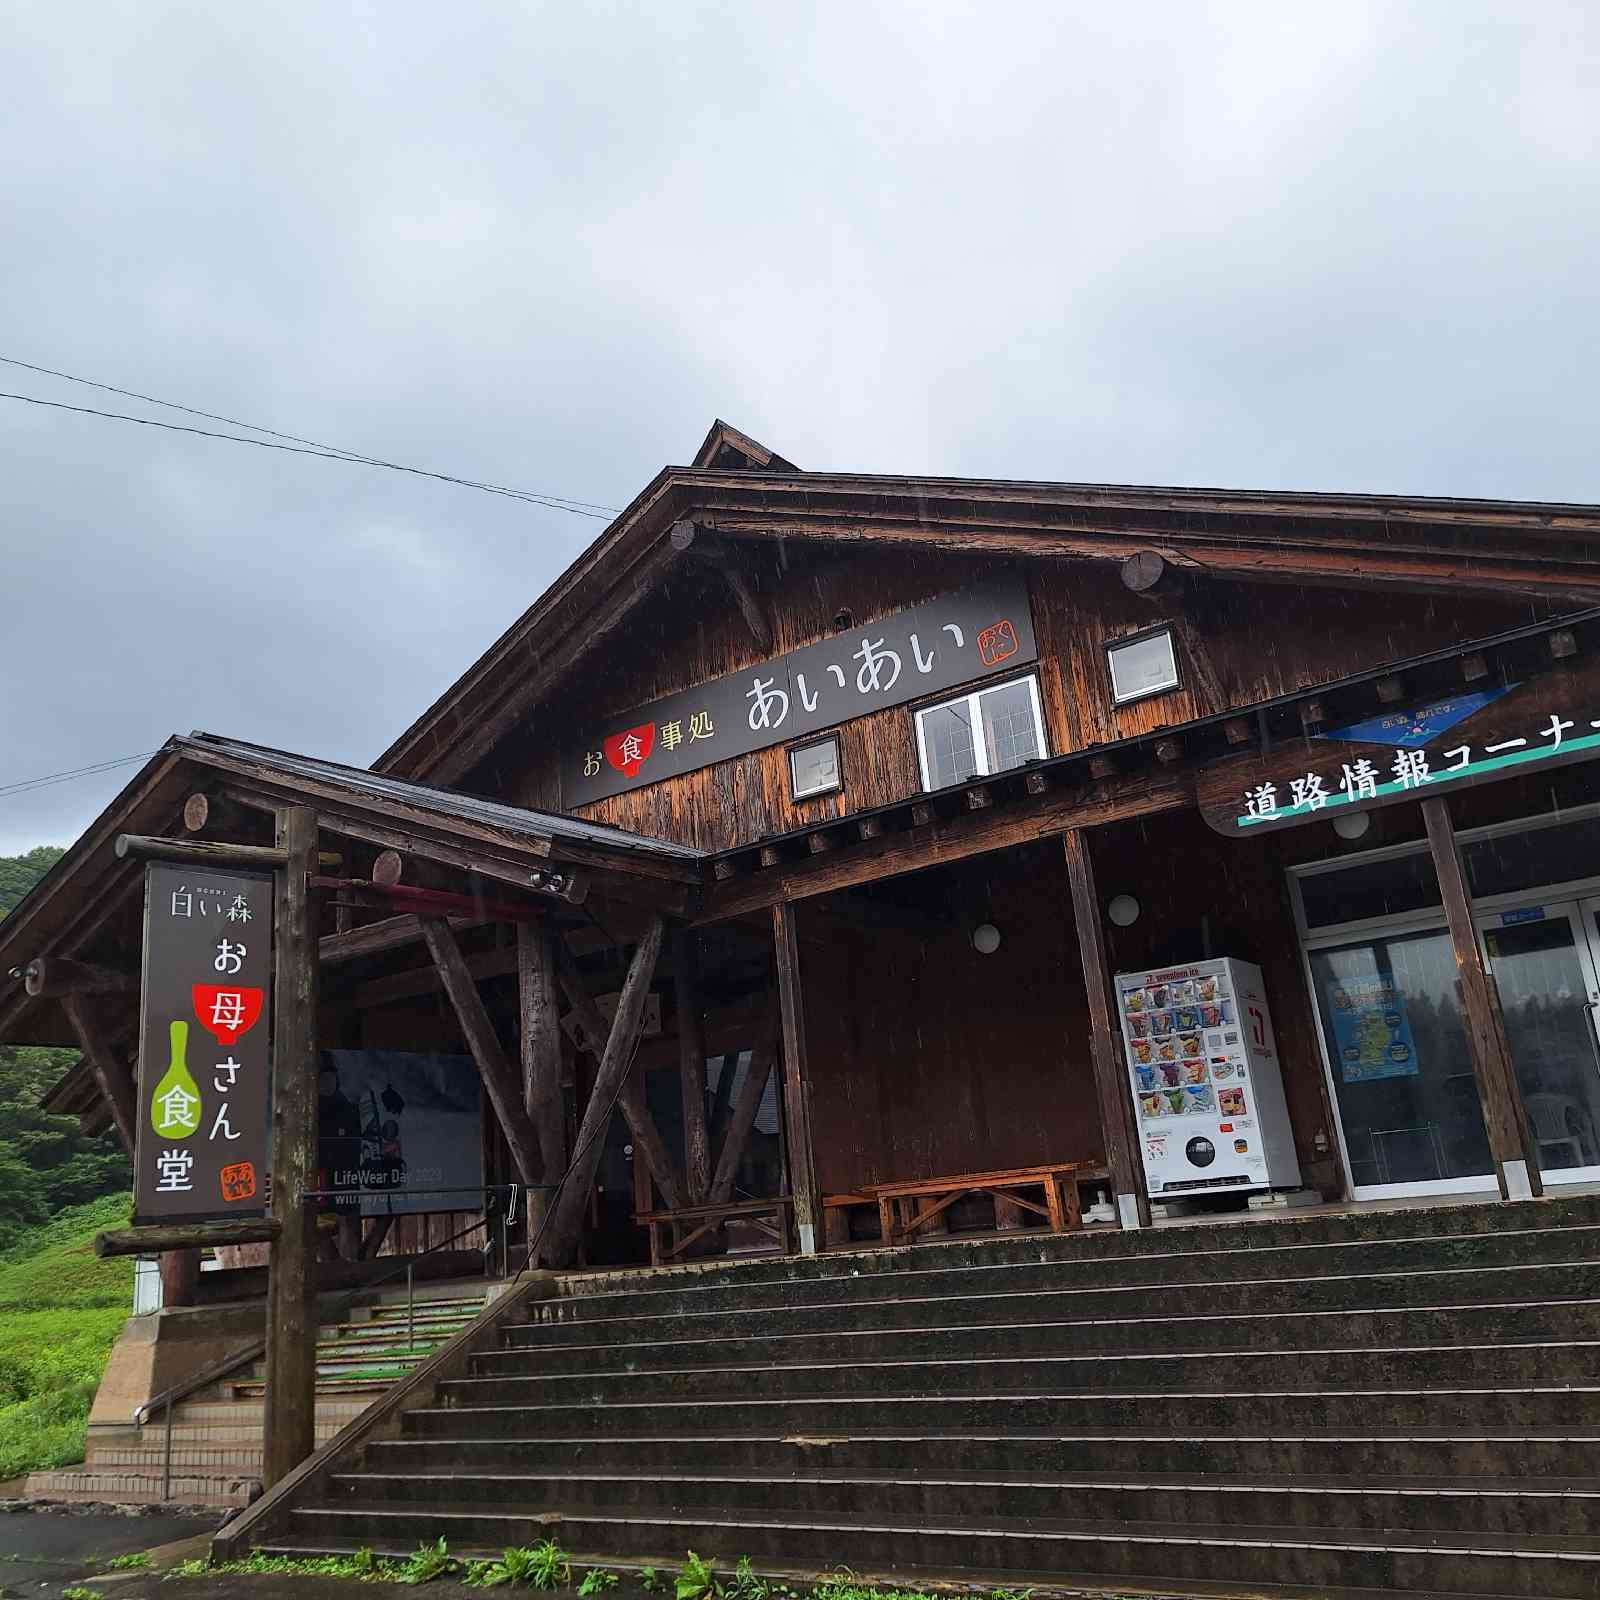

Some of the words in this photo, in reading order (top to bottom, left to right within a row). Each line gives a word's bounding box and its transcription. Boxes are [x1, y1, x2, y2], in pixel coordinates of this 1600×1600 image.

[582, 711, 715, 778] お食事処
[745, 623, 965, 731] あいあい
[1243, 713, 1600, 822] 道路情報コーナ
[171, 886, 253, 923] 白い森
[208, 938, 247, 1142] お母さん
[155, 1083, 199, 1192] 食堂
[334, 1169, 387, 1185] LifeWear
[391, 1168, 413, 1184] Da
